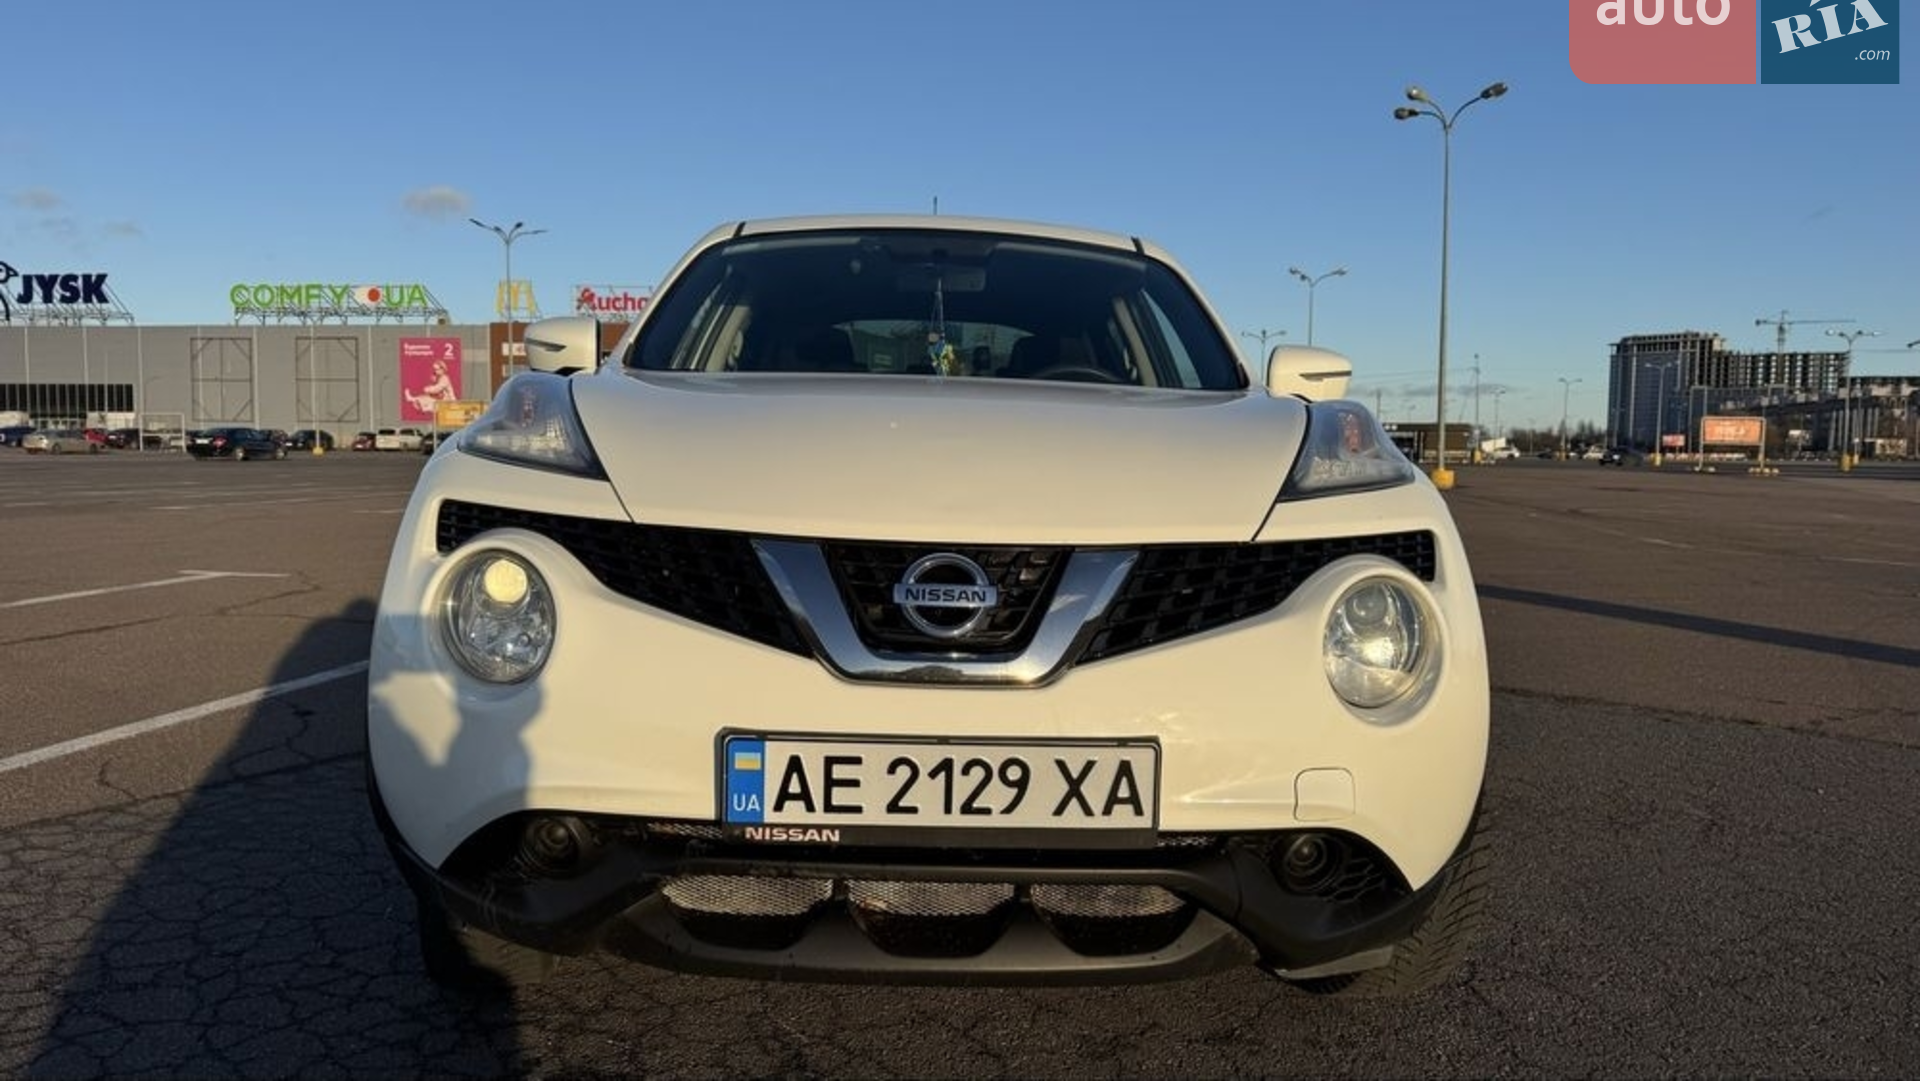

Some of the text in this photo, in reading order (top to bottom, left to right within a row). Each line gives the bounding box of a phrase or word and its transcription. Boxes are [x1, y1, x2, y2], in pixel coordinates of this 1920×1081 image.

[17, 273, 108, 304] JYSK
[230, 283, 350, 308] COMFY
[444, 342, 454, 356] 2
[905, 587, 986, 603] NISSAN
[773, 754, 1145, 817] AE 2129 XA
[732, 793, 761, 812] UA
[745, 826, 840, 843] NISSAN
